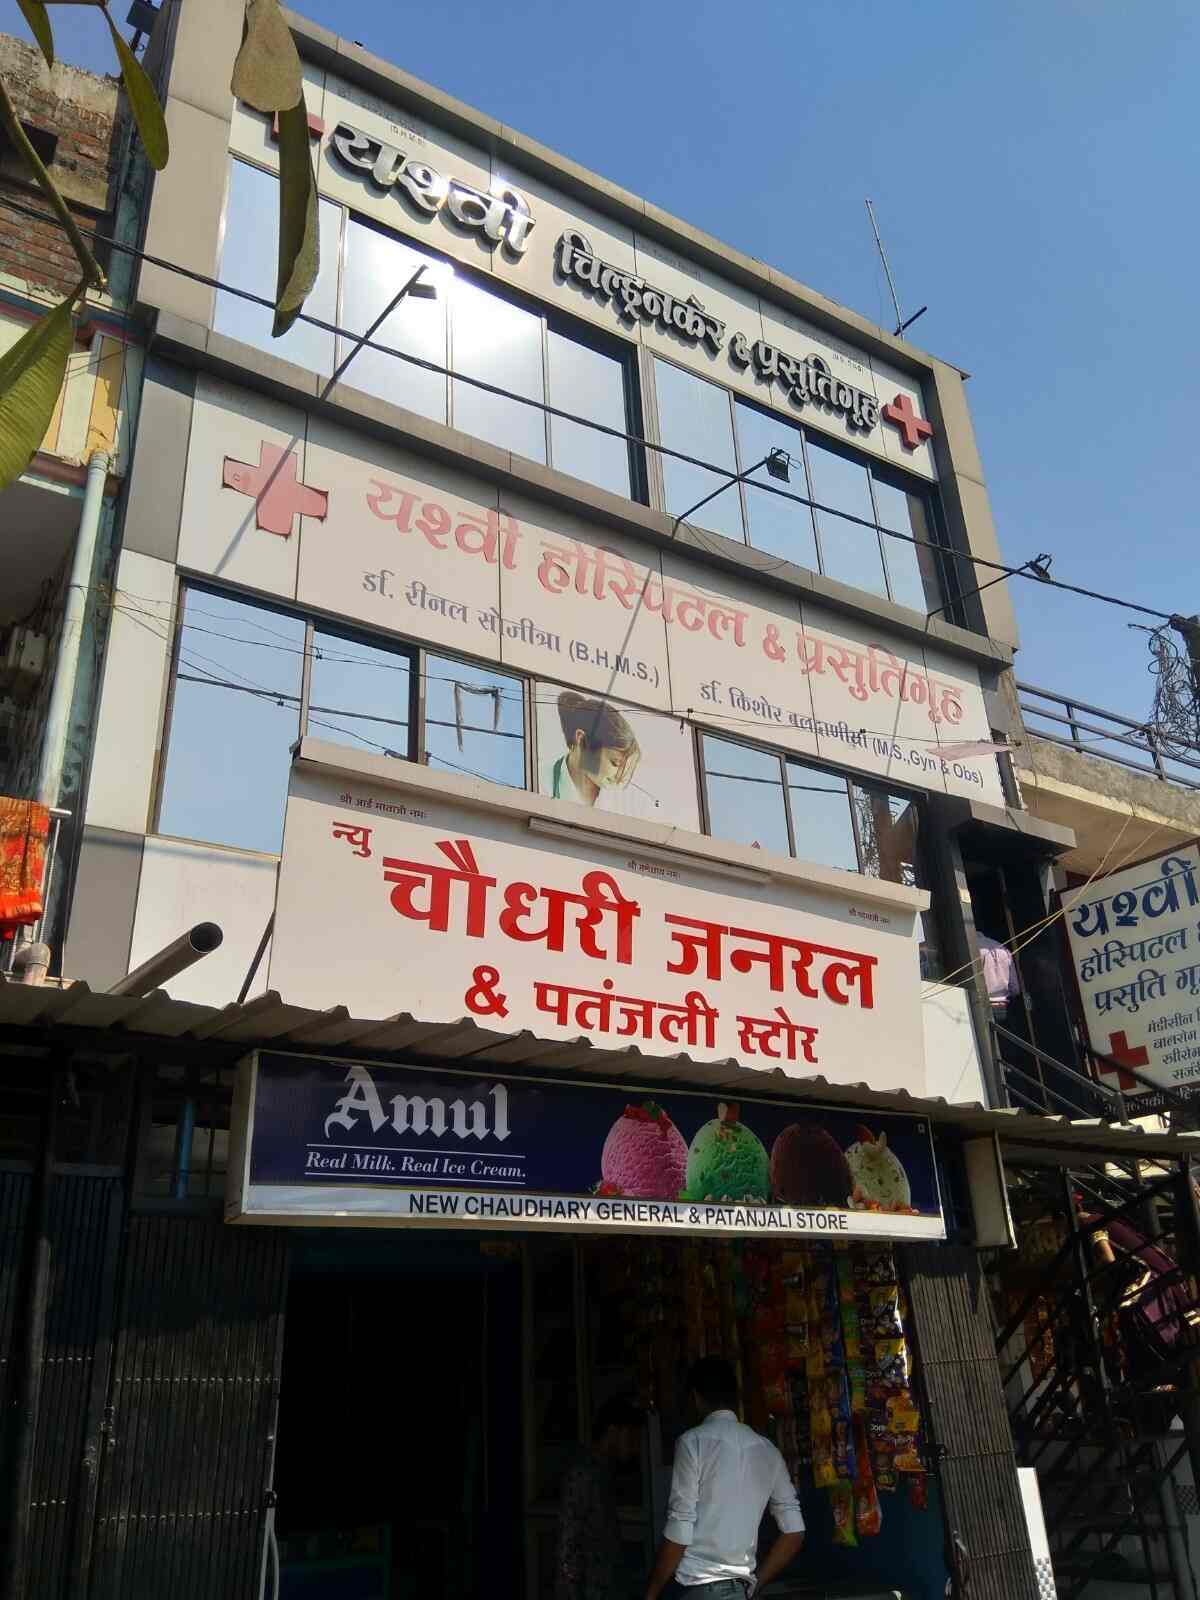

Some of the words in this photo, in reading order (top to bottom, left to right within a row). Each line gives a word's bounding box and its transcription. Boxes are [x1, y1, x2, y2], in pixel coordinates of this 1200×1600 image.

[365, 477, 524, 571] यश्वी
[763, 623, 786, 664] &
[567, 639, 661, 688] (B.H.M.S.)
[953, 761, 984, 788] Obs)
[332, 821, 373, 858] न्यु
[382, 839, 641, 966] चौधरी
[664, 912, 879, 1010] जनरल
[465, 964, 510, 1018] &
[533, 977, 720, 1049] पतंजली
[736, 1006, 819, 1064] स्टोर
[324, 1066, 511, 1142] Amul
[305, 1151, 347, 1169] Real
[352, 1154, 396, 1171] Milk.
[401, 1156, 438, 1173] Real
[442, 1158, 465, 1175] Ice
[470, 1159, 526, 1178] Cream.
[409, 1193, 460, 1213] NEW
[464, 1196, 593, 1219] CHAUDHARY
[597, 1202, 684, 1223] GENERAL
[688, 1206, 701, 1225] &
[705, 1208, 792, 1230] PATANJALI
[796, 1211, 849, 1230] STORE
